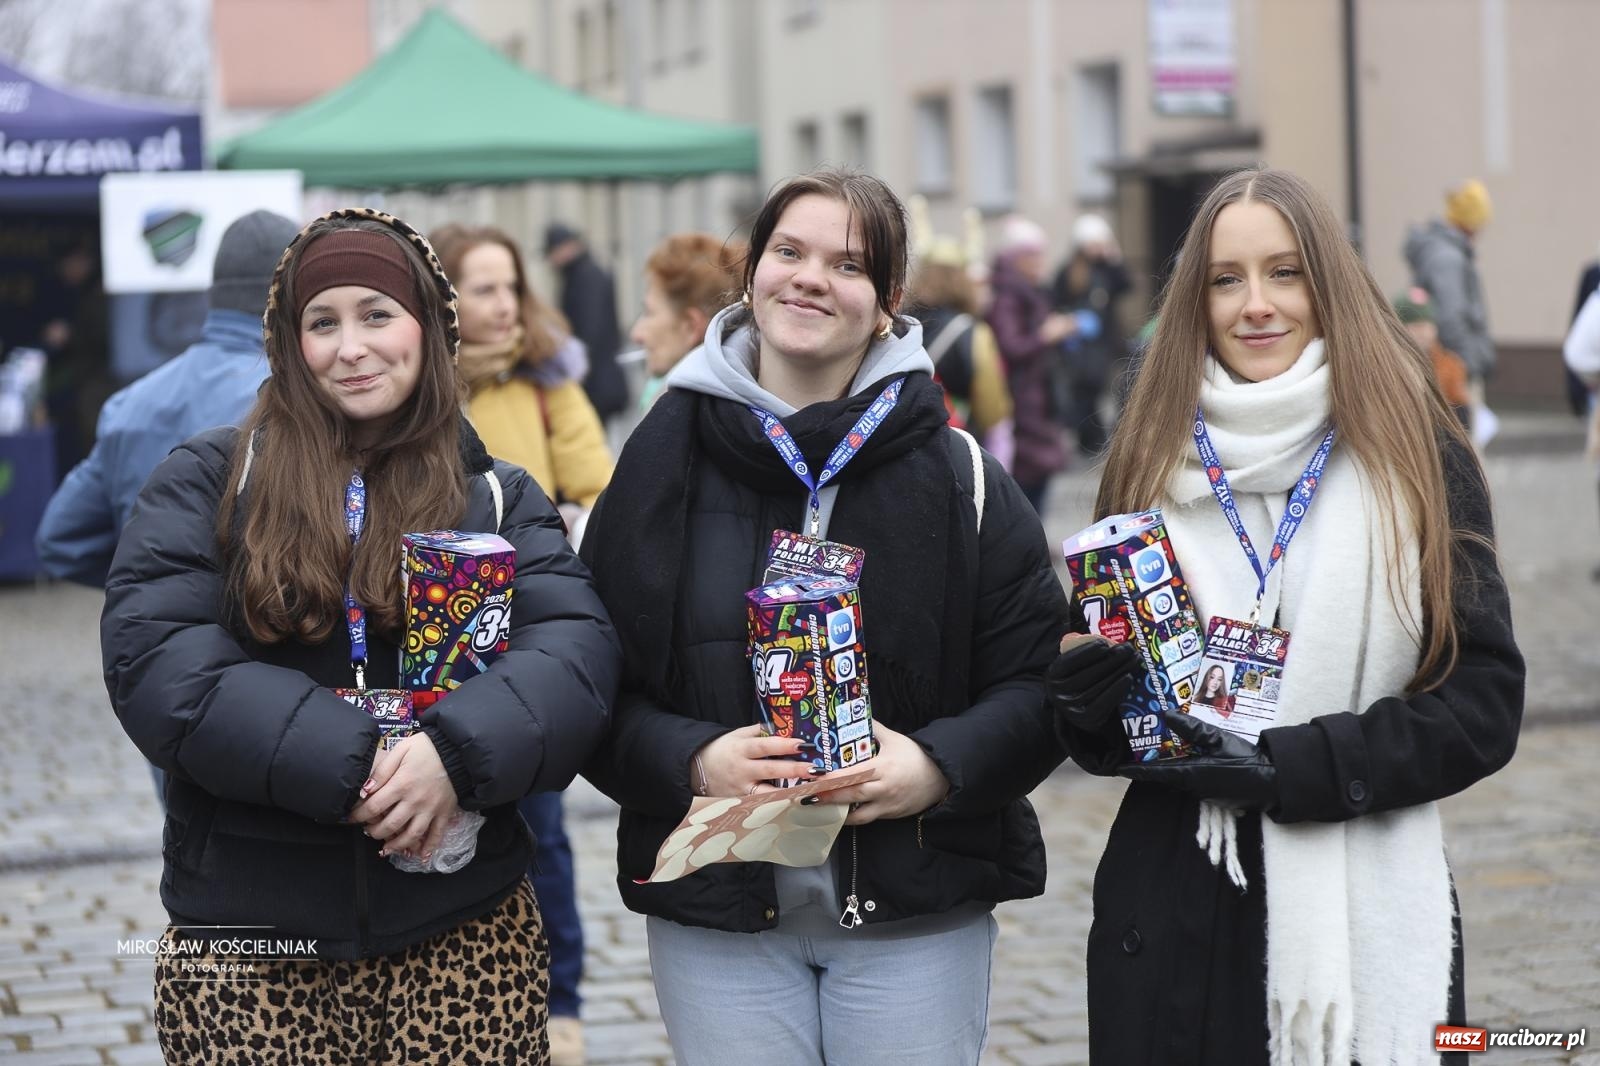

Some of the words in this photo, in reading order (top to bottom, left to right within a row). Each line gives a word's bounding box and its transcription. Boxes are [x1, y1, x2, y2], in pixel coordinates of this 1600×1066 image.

[1215, 484, 1230, 505] 112
[778, 538, 791, 550] A
[822, 552, 855, 571] 34
[1140, 558, 1161, 574] tvn
[484, 593, 506, 605] 2026
[809, 614, 821, 656] CHOROBY
[833, 623, 850, 635] tvn
[1110, 558, 1131, 600] CHOROBY
[1125, 599, 1146, 647] PRZEWODU
[1142, 646, 1169, 712] POKARMOWEGO
[1213, 624, 1226, 637] A
[1256, 637, 1283, 656] 34
[756, 652, 789, 692] 34
[814, 655, 826, 706] PRZEWODU
[373, 697, 403, 718] 34
[818, 705, 833, 772] POKARMOWEGO
[1129, 735, 1162, 748] SWOJE
